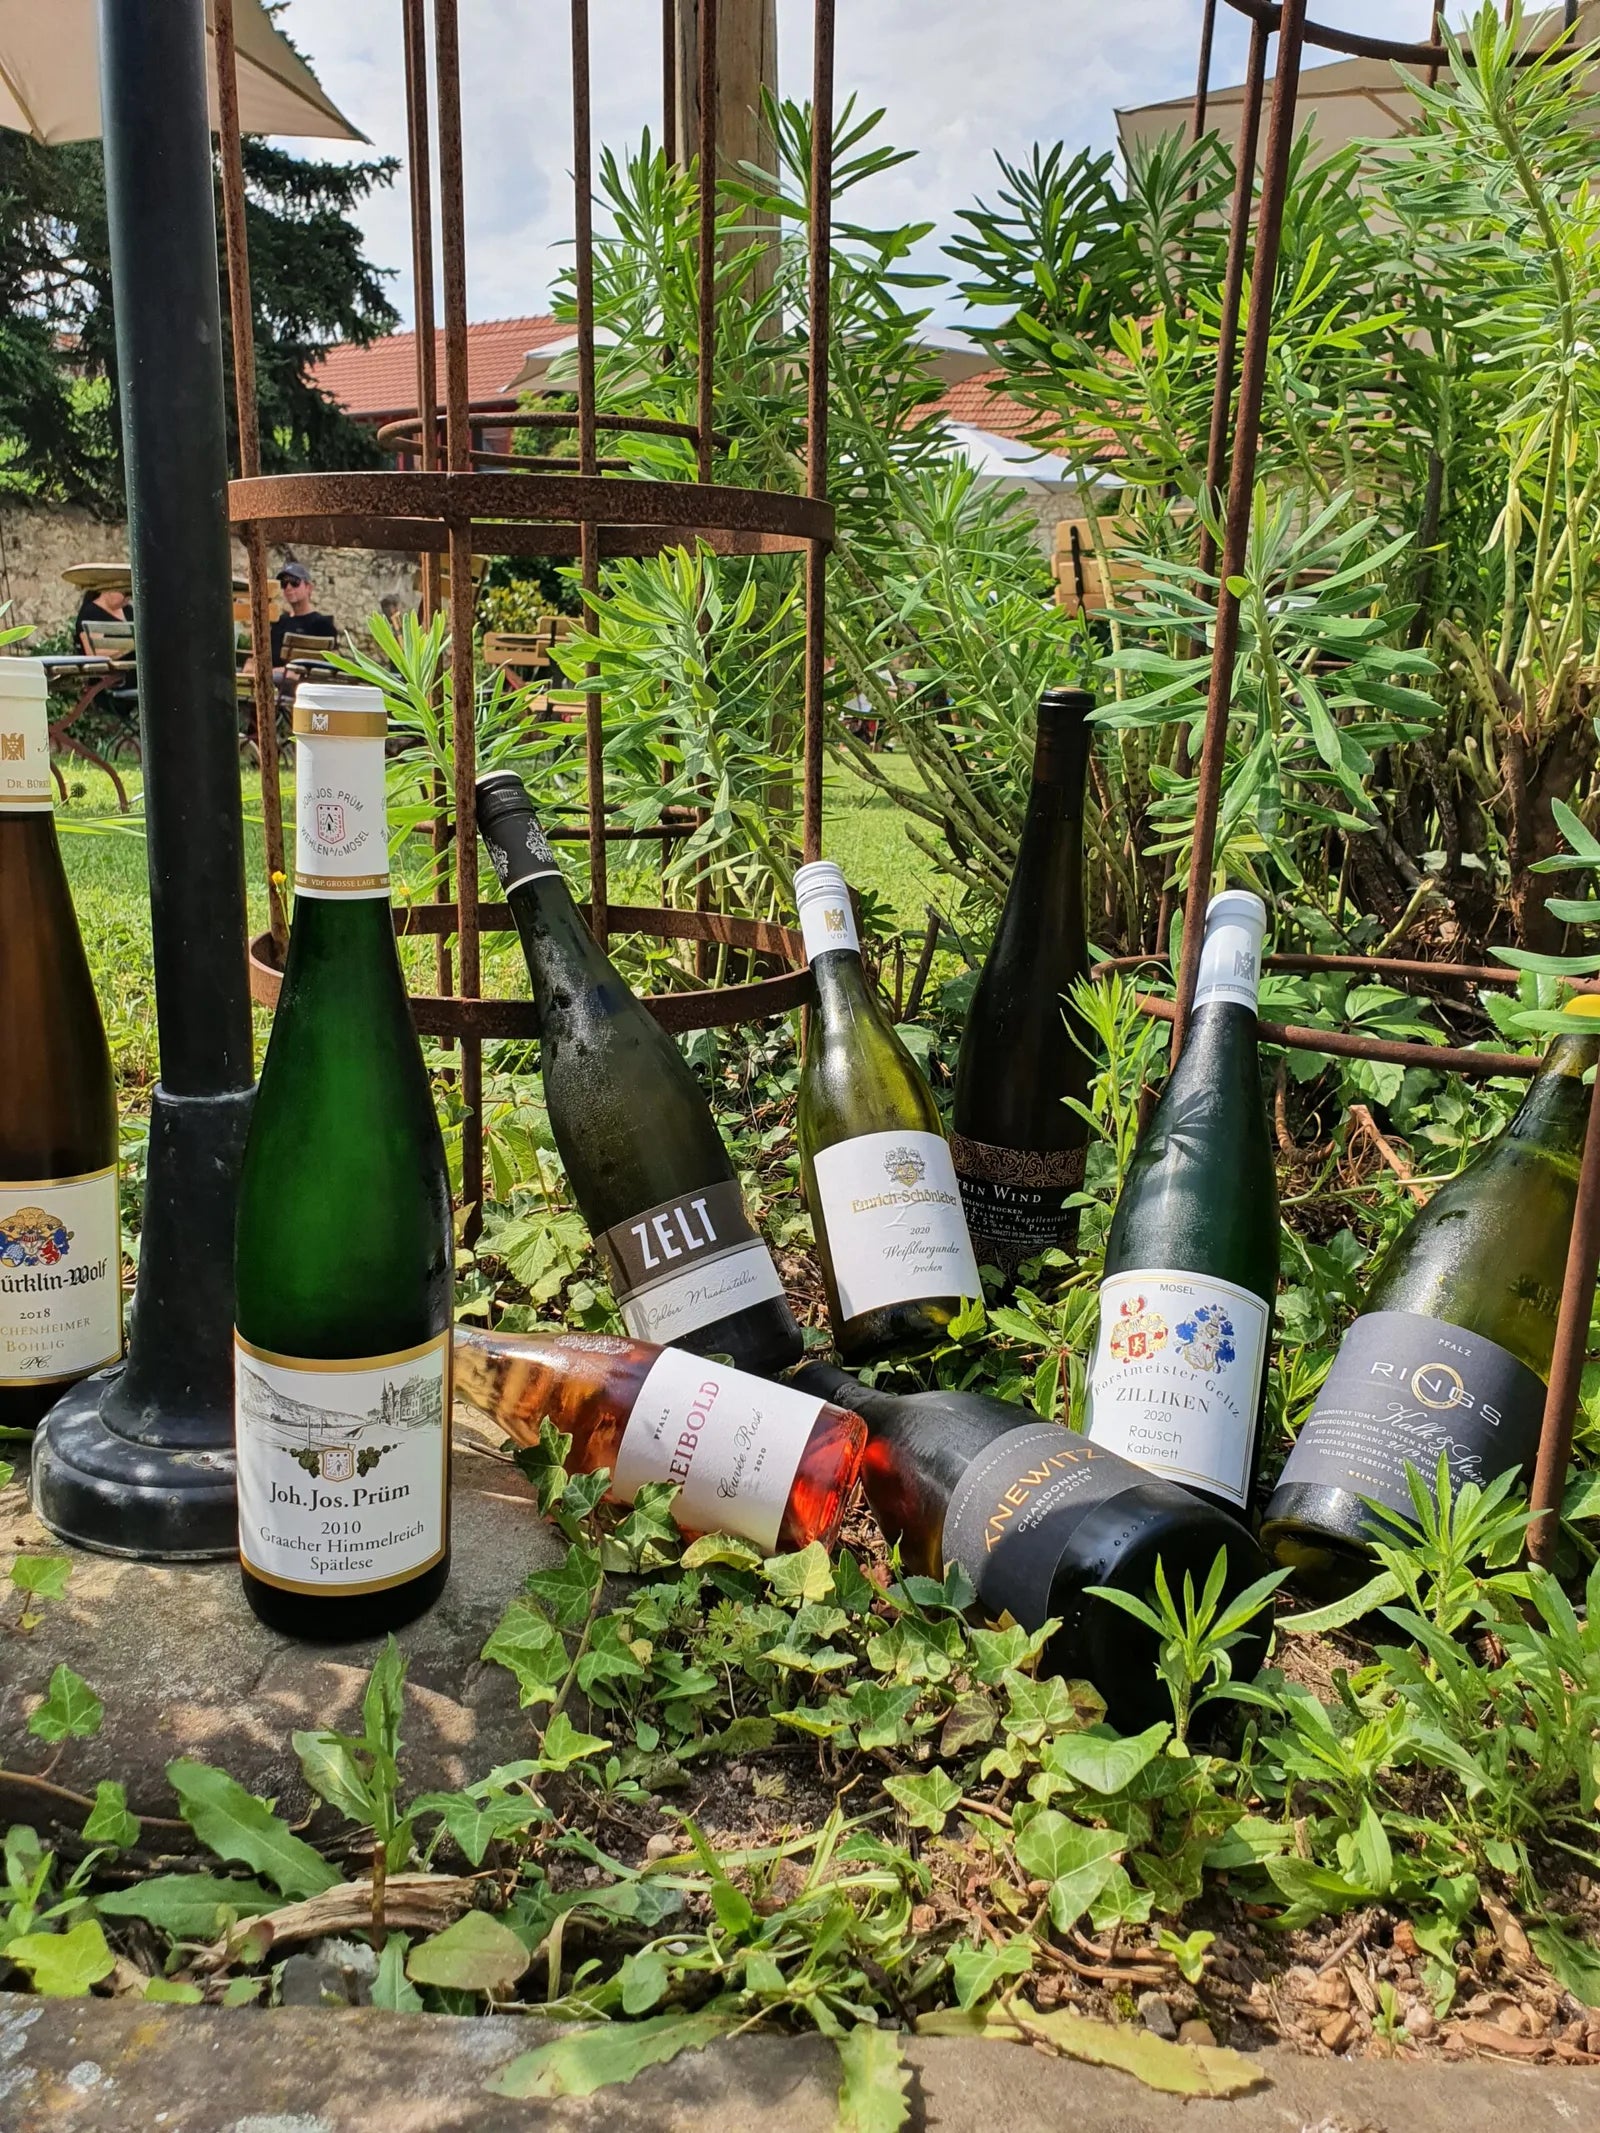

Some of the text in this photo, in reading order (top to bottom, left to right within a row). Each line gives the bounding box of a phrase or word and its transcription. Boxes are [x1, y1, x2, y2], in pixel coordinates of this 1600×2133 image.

[337, 790, 364, 812] PRÜM
[343, 829, 369, 855] MOSEL
[357, 878, 376, 886] LAGE
[630, 1198, 718, 1271] ZELT
[909, 1225, 931, 1235] 2020
[882, 1240, 961, 1262] Weißburgunder
[0, 1258, 108, 1293] ürklin-Wolf
[909, 1260, 943, 1276] trocken
[1159, 1283, 1195, 1295] MOSEL
[20, 1308, 51, 1320] 2018
[0, 1318, 91, 1336] CHENHEIMER
[1438, 1338, 1473, 1357] PFALZ
[1115, 1387, 1211, 1413] ZILLIKEN
[1204, 1378, 1241, 1418] Geltz
[1369, 1361, 1502, 1427] RINGS
[654, 1408, 670, 1441] PFALZ
[1143, 1410, 1172, 1423] 2020
[1128, 1425, 1182, 1444] Rausch
[1361, 1423, 1380, 1433] VOM
[1381, 1428, 1416, 1446] BUNTEN
[716, 1407, 764, 1499] Cuvée Rosé
[754, 1447, 767, 1473] 2020
[1126, 1442, 1179, 1460] Kabinett
[1356, 1455, 1393, 1474] GEREIFT
[1065, 1474, 1094, 1493] 2018
[269, 1481, 410, 1512] Joh. Jos. Prüm
[952, 1483, 976, 1529] WEINGUT
[984, 1447, 1105, 1553] KNEWITZ
[1017, 1466, 1093, 1533] CHARDONNAY
[259, 1520, 425, 1553] Graacher Himmelreich
[321, 1520, 361, 1535] 2010
[310, 1556, 374, 1575] Spätlese
